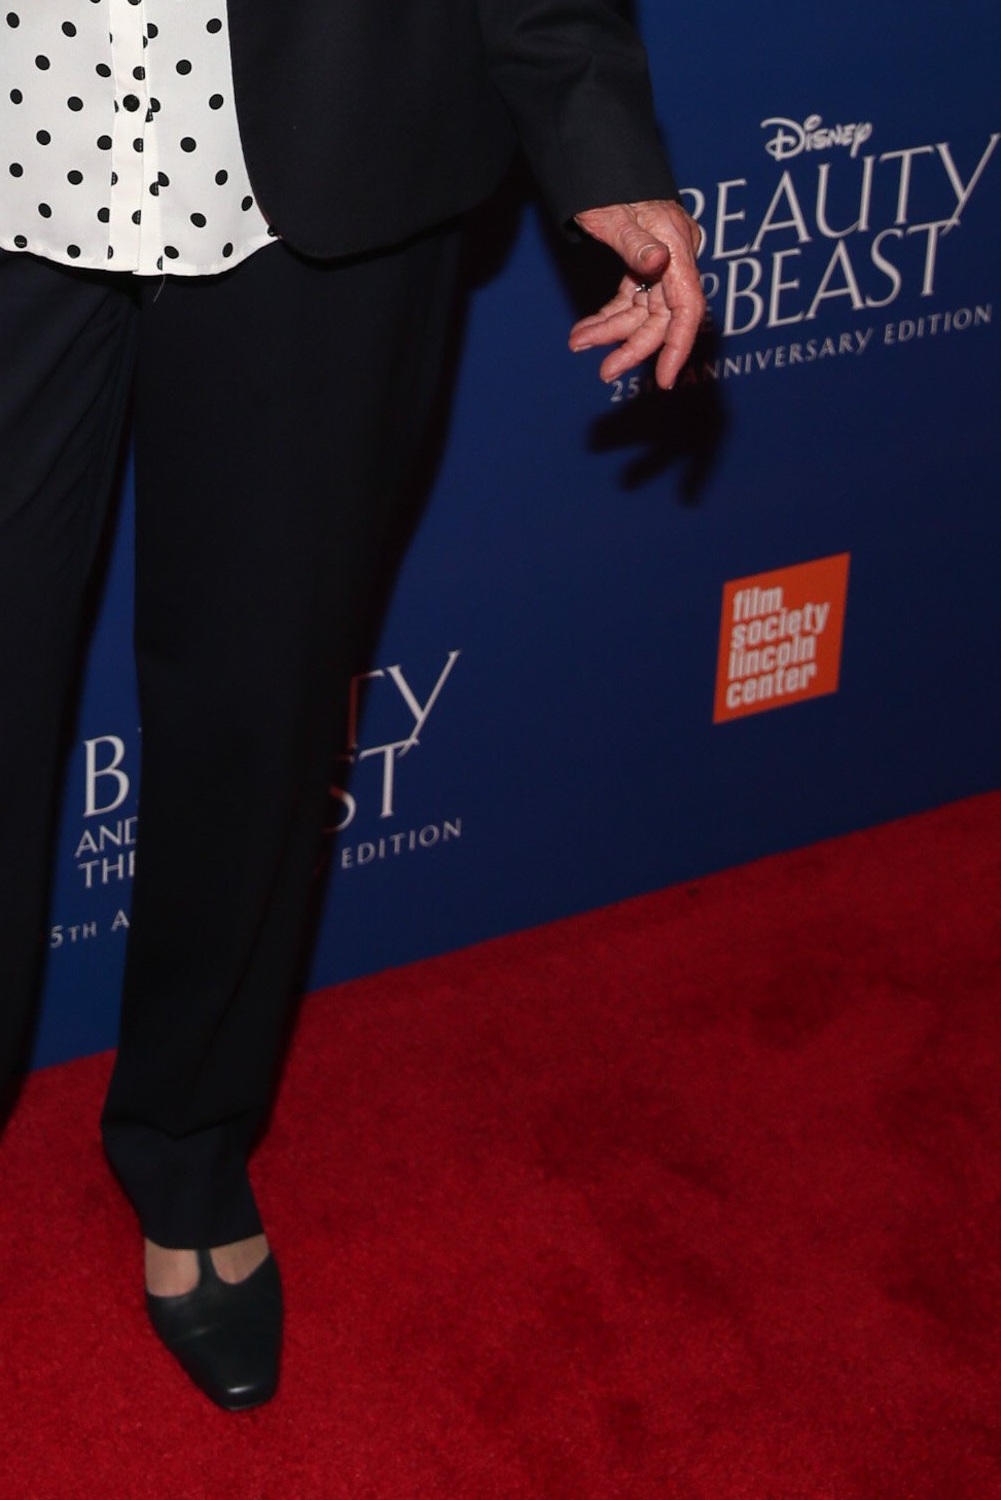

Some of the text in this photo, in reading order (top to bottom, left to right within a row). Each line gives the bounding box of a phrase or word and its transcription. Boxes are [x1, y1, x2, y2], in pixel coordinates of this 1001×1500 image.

[722, 217, 960, 338] BEAST
[684, 327, 874, 385] NNIVERSARY
[883, 302, 993, 345] EDITION
[731, 602, 831, 649] society
[733, 585, 784, 622] film
[728, 634, 817, 680] lincoln
[725, 661, 817, 710] center
[50, 920, 97, 949] 5TH
[341, 817, 463, 869] EDITION
